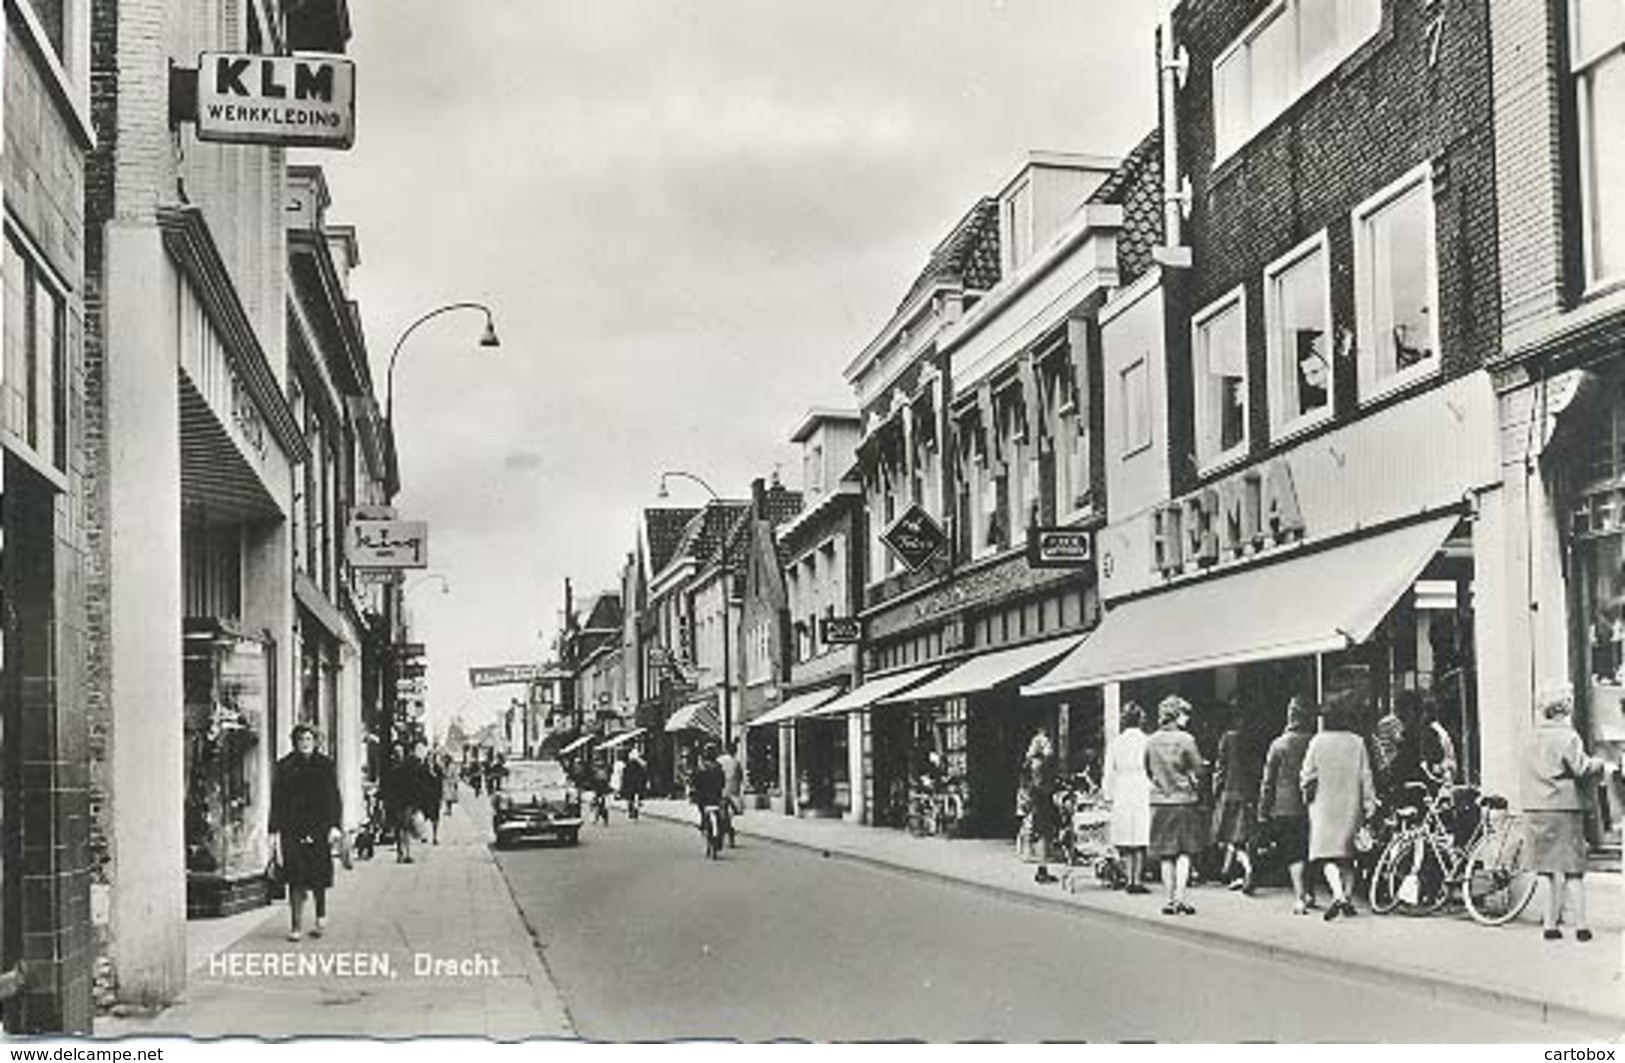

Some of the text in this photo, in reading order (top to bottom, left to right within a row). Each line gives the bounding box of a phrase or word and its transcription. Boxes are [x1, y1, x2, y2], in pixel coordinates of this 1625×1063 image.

[216, 57, 334, 103] KLM
[207, 105, 340, 127] WERKKLEDING
[1152, 455, 1305, 576] HEMA
